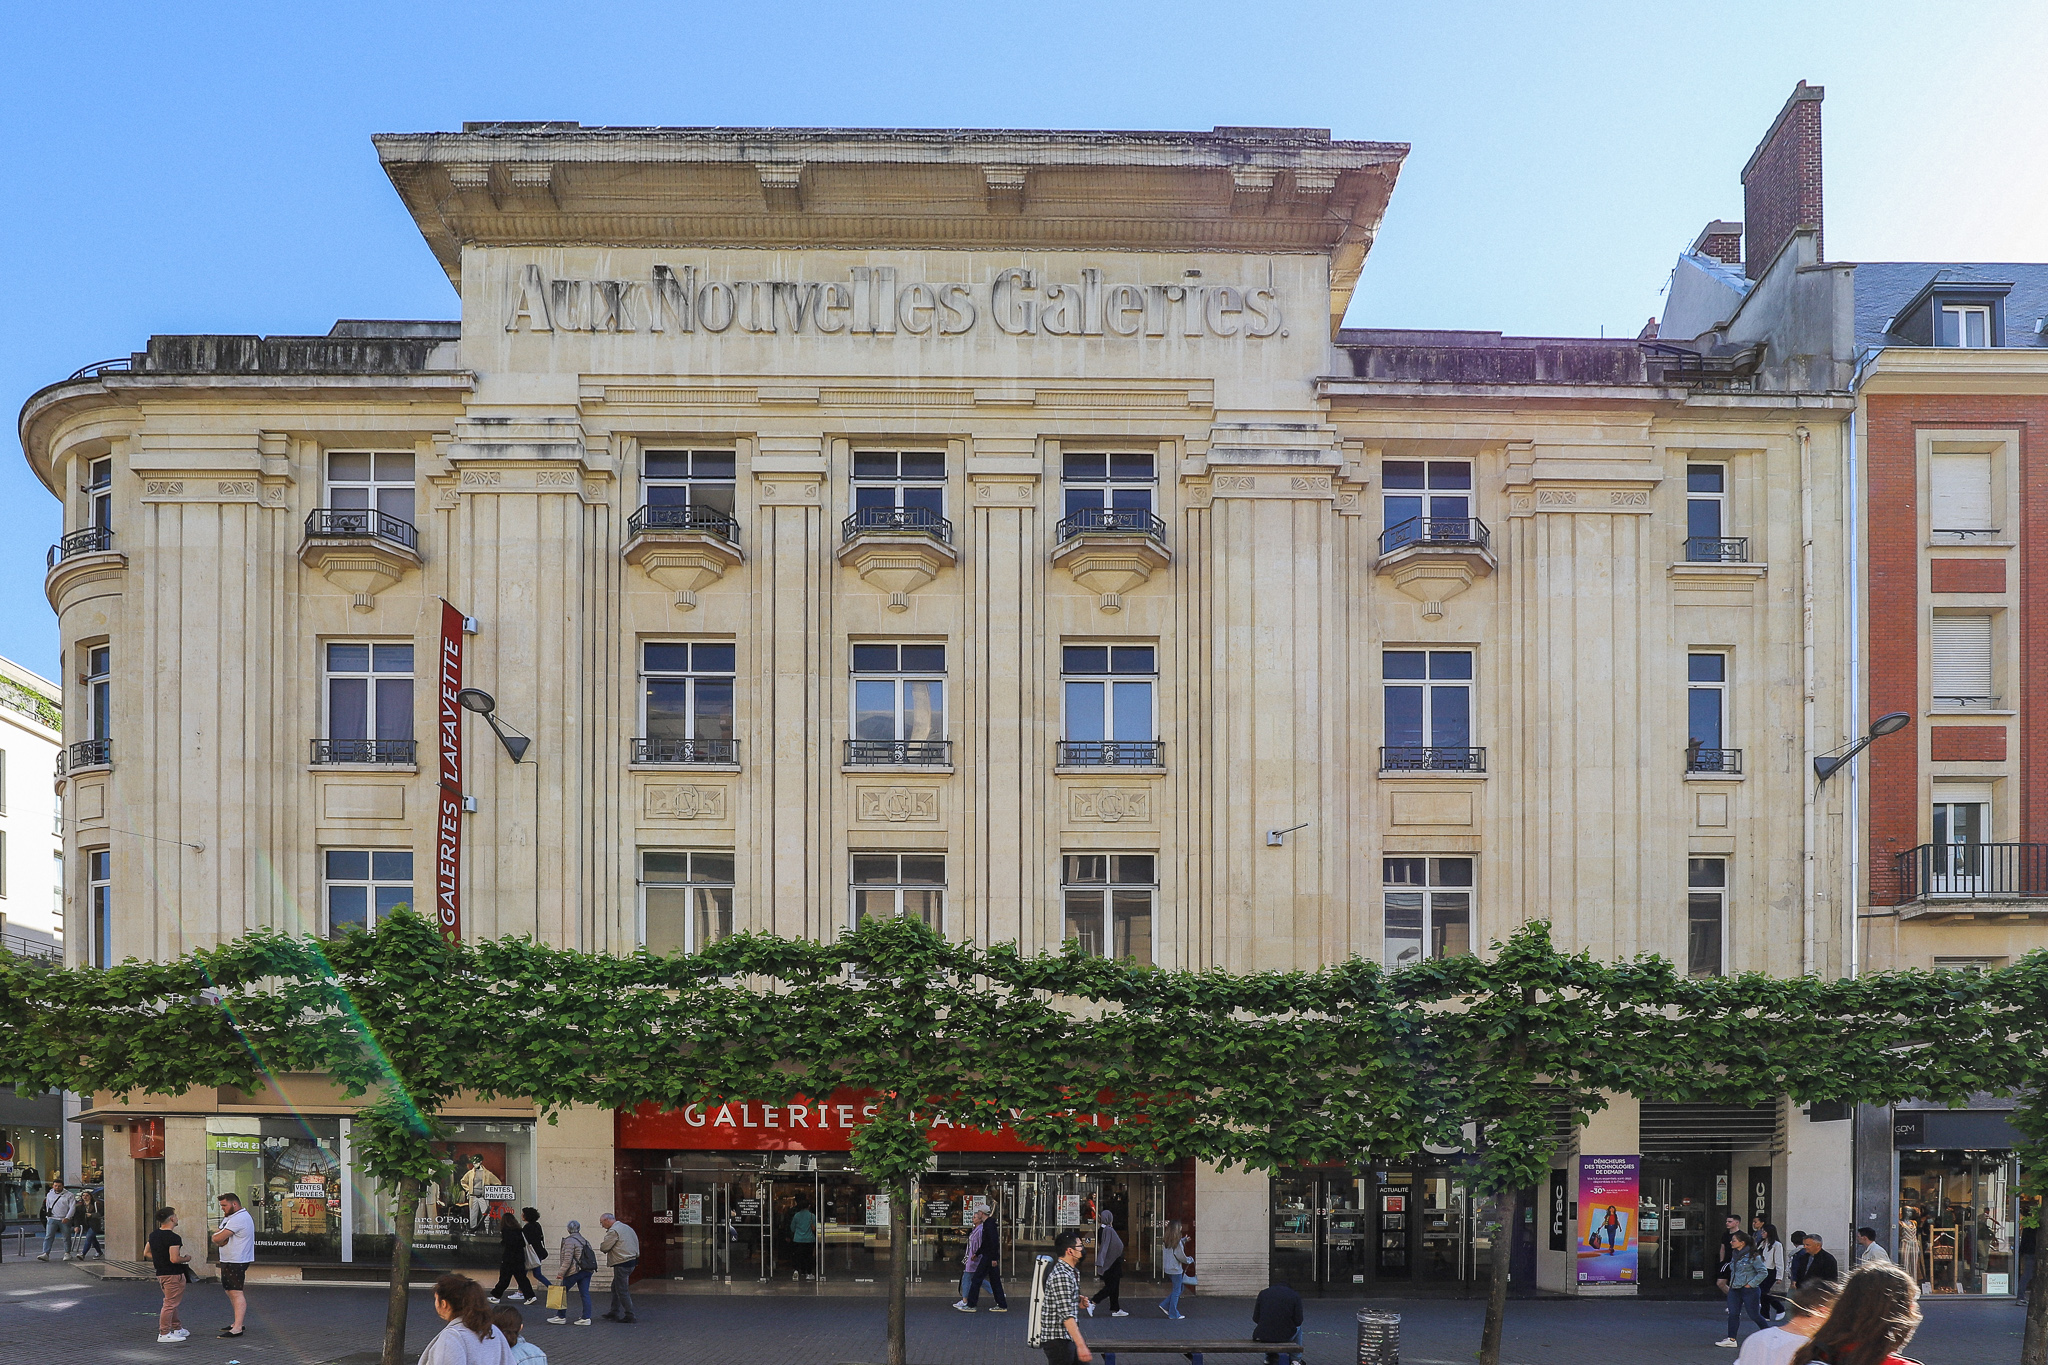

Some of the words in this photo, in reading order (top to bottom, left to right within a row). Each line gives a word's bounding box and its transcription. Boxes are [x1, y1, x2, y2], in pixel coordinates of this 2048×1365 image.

[505, 264, 636, 334] Aux
[650, 264, 976, 335] Nouvelles
[444, 636, 461, 784] LAFAYETTE
[440, 799, 458, 927] GALERIES
[436, 1216, 469, 1224] O'Polo
[1553, 1185, 1563, 1235] fnac
